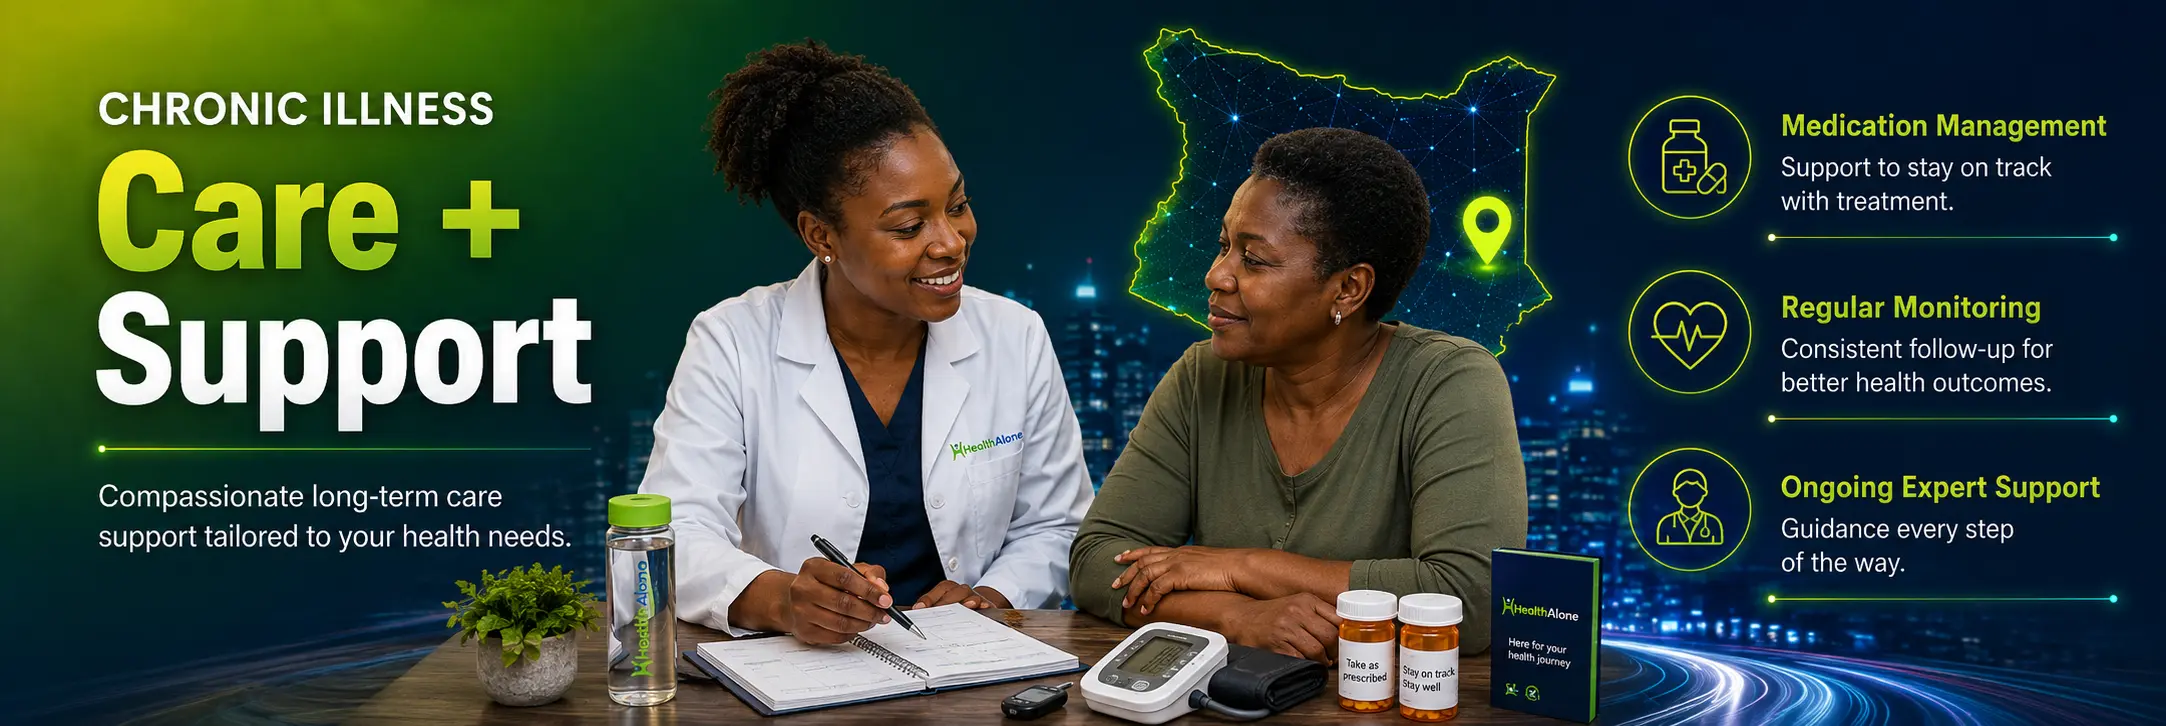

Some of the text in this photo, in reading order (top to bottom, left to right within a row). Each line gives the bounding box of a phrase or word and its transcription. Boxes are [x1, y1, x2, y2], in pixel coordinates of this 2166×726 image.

[963, 431, 1024, 455] HealthAlone
[1514, 604, 1579, 621] HealthAlone
[1508, 637, 1567, 654] Here for your
[1346, 658, 1379, 670] Take as
[1508, 650, 1571, 670] health journey
[1343, 672, 1387, 683] prescribed
[1402, 665, 1455, 679] Stay on track
[1402, 679, 1441, 693] Stay well
